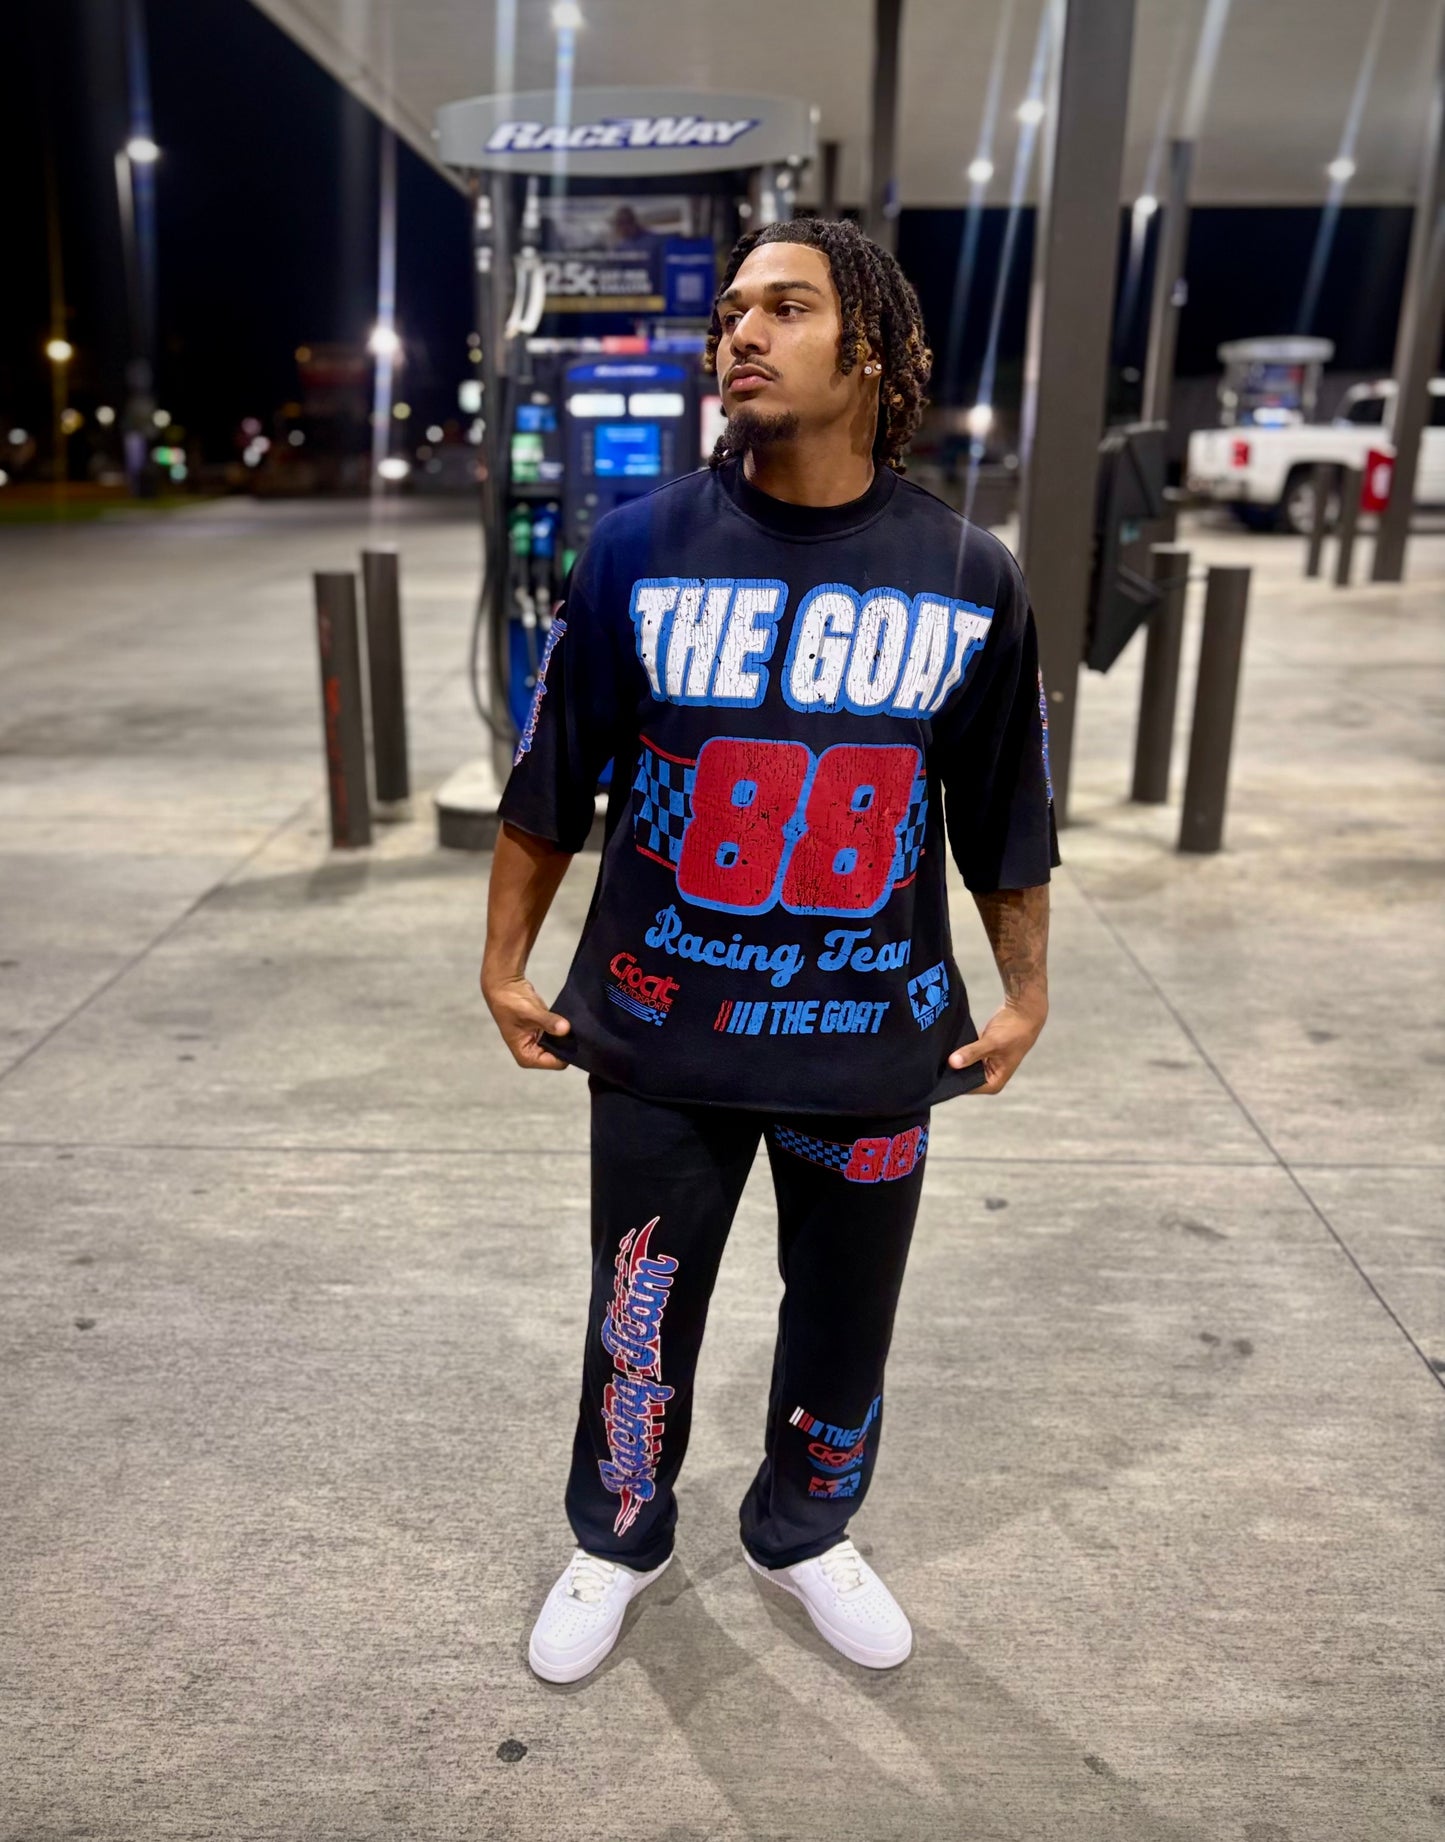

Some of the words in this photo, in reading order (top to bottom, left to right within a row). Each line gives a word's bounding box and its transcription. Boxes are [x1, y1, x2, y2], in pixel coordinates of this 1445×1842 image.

[632, 580, 785, 702] THE
[784, 585, 995, 716] GOAT
[676, 737, 923, 917] 88
[645, 905, 804, 988] Racing
[769, 1000, 820, 1035] THE
[820, 1000, 890, 1034] GOAT
[843, 1125, 922, 1183] 88
[823, 1424, 861, 1447] THE
